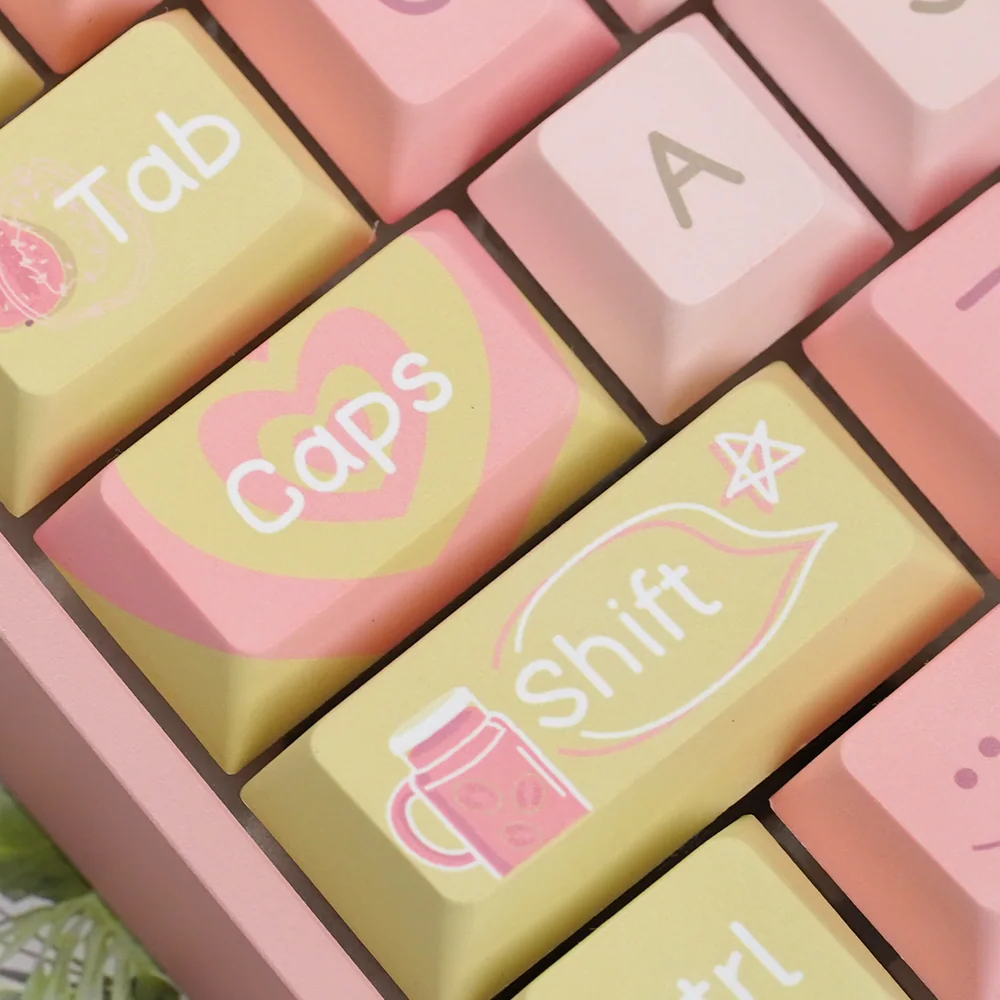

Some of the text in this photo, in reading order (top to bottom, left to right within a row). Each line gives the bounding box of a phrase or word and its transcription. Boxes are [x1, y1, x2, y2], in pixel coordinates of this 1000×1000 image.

[53, 111, 241, 243] Tab
[647, 130, 746, 230] A
[226, 351, 454, 534] Caps
[515, 563, 723, 729] Shift
